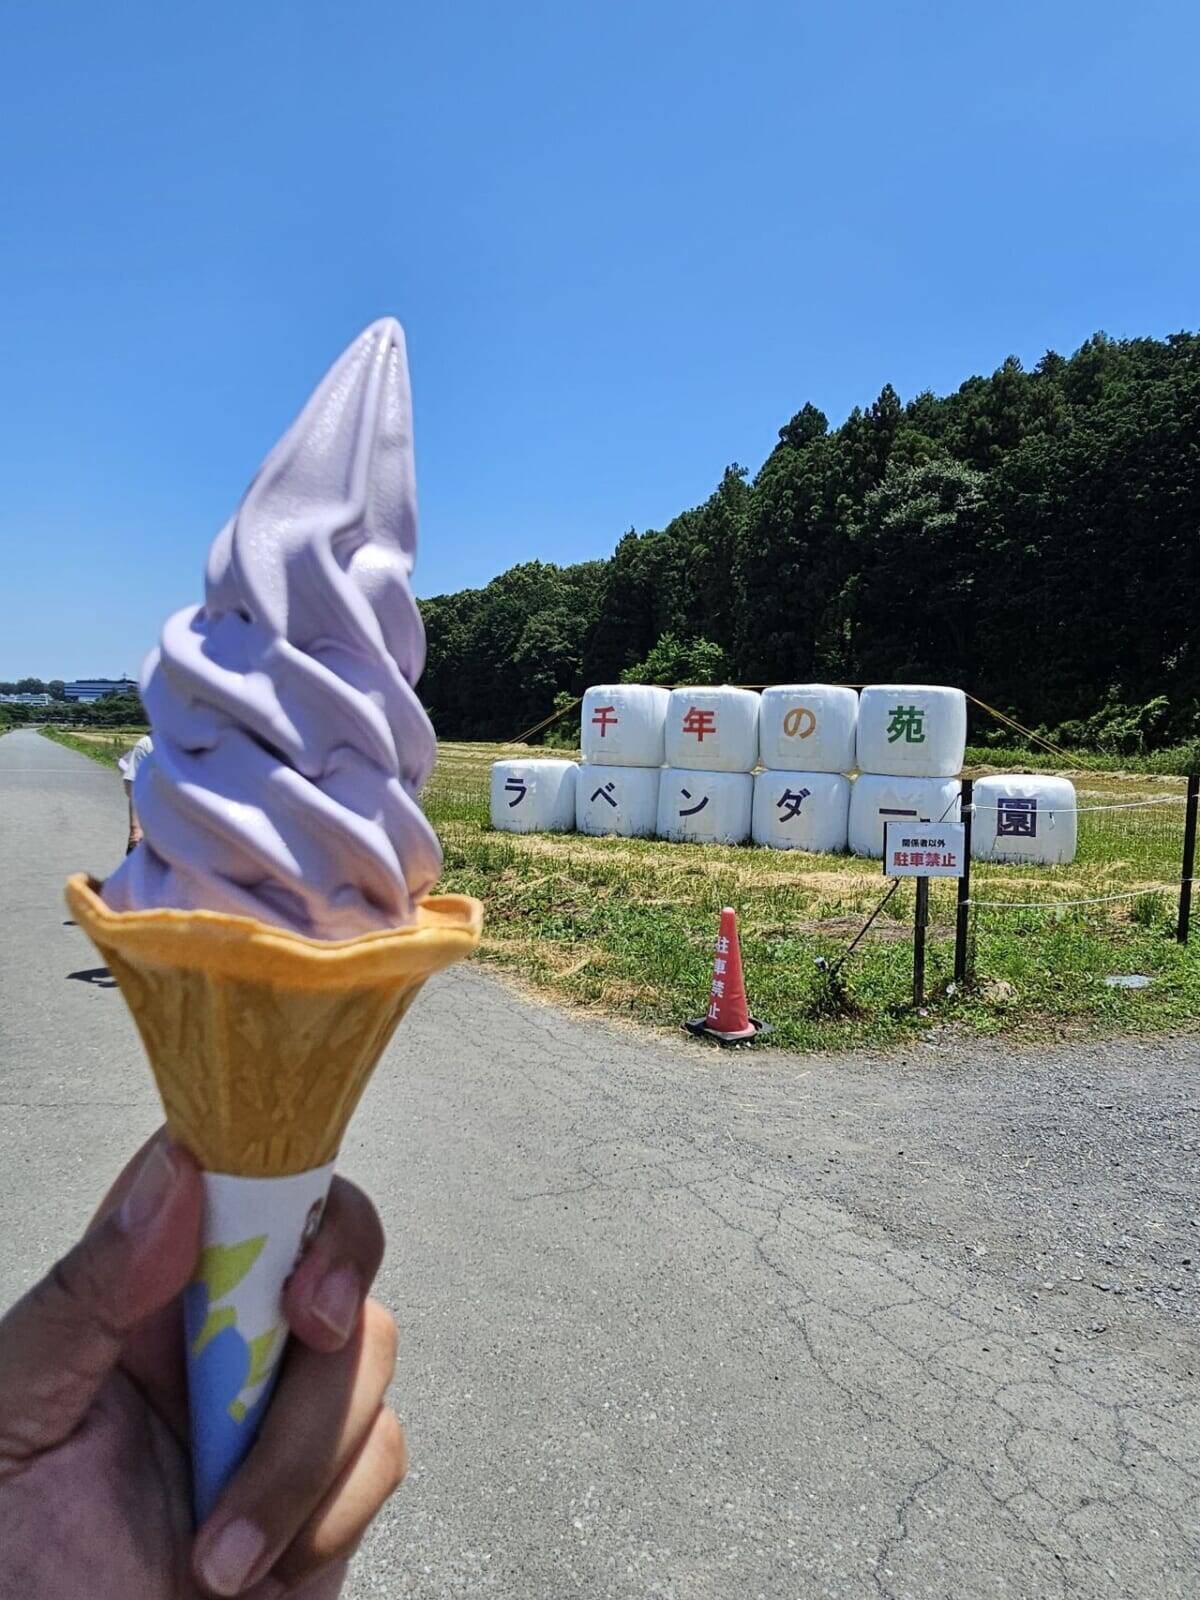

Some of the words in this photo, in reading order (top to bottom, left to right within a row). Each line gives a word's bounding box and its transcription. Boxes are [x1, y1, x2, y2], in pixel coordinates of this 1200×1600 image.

[592, 705, 926, 743] 千年の苑
[902, 838, 946, 848] 関係者以外
[893, 851, 957, 867] 駐車禁止
